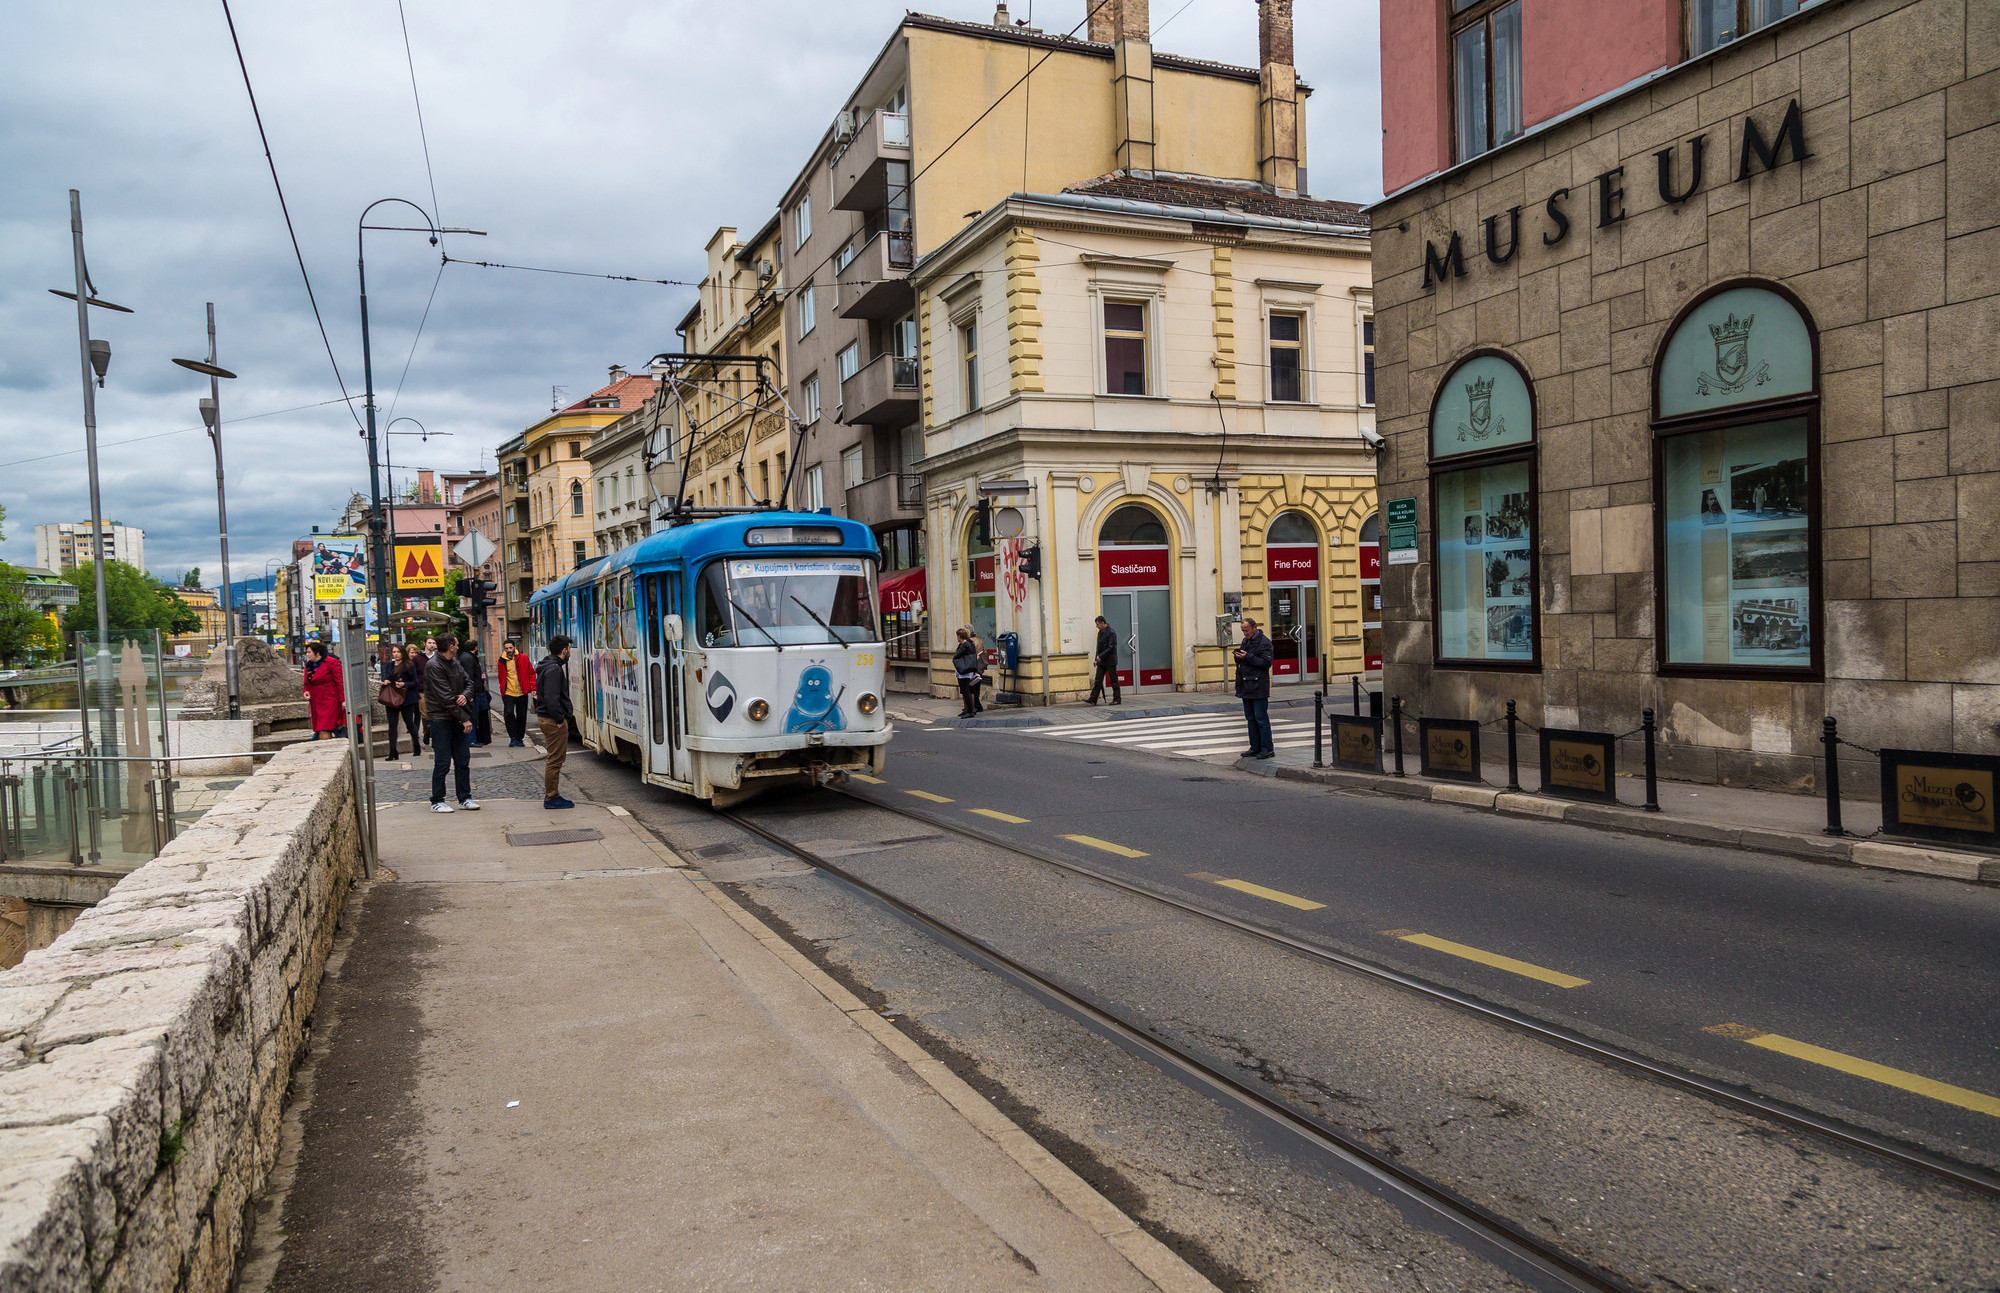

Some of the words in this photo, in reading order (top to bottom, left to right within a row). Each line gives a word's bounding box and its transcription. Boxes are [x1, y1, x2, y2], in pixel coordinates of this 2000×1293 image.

[1421, 99, 1814, 289] MUSEUM
[754, 563, 788, 574] Kupujmo
[794, 562, 830, 572] koristimo
[1111, 564, 1157, 574] Slastičarna
[1274, 560, 1291, 569] Fine
[1292, 559, 1312, 569] Food
[980, 571, 994, 580] Pekara
[891, 590, 924, 609] LISCA
[856, 653, 873, 666] 258
[1913, 775, 1953, 798] MUZEJ
[1902, 784, 1963, 808] SARAJEVA
